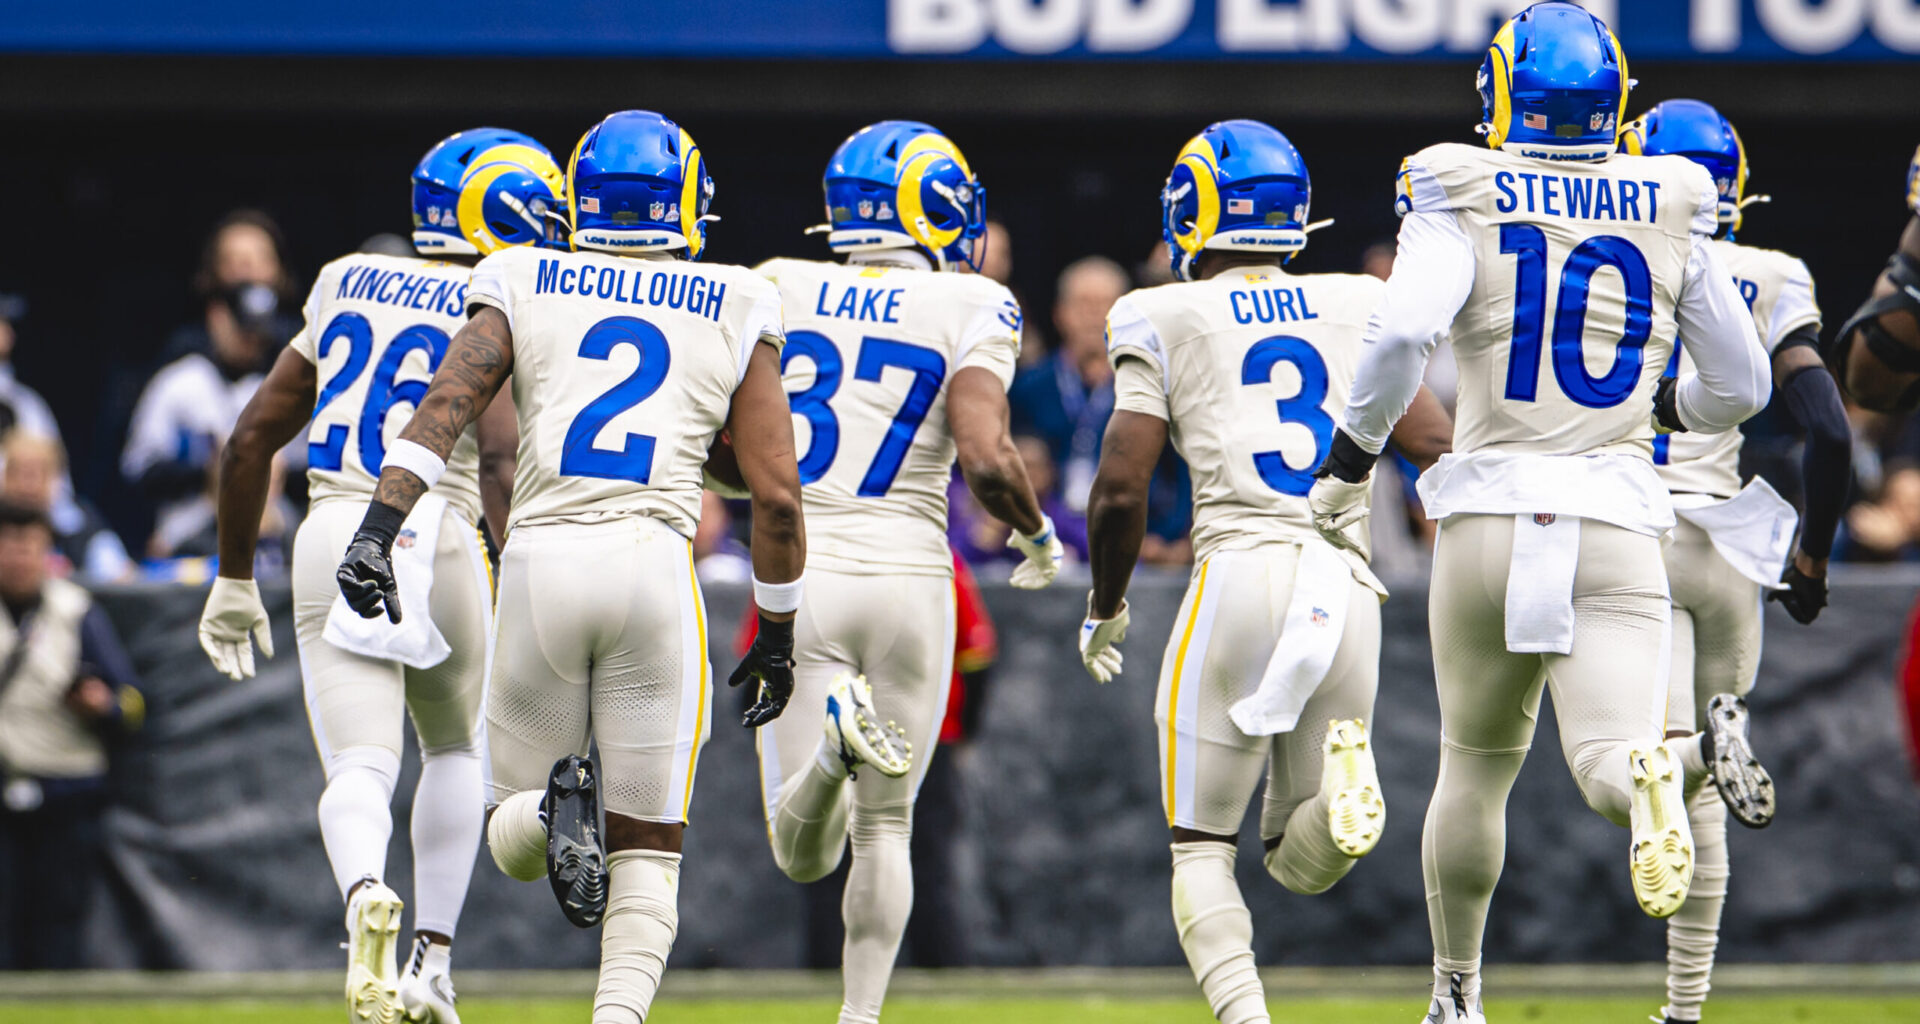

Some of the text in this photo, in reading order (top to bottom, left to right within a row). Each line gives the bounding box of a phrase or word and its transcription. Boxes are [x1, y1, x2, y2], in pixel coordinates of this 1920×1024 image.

[1216, 0, 1620, 53] LIGH
[1495, 171, 1660, 224] STEWART
[584, 236, 607, 245] LOS
[336, 265, 467, 318] KINCHENS
[535, 259, 726, 322] McCOLLOUGH
[815, 281, 905, 324] LAKE
[1229, 286, 1319, 325] CURL
[1499, 222, 1653, 409] 10
[306, 311, 452, 479] 26
[559, 315, 671, 486] 2
[780, 329, 947, 498] 37
[1241, 335, 1335, 498] 3
